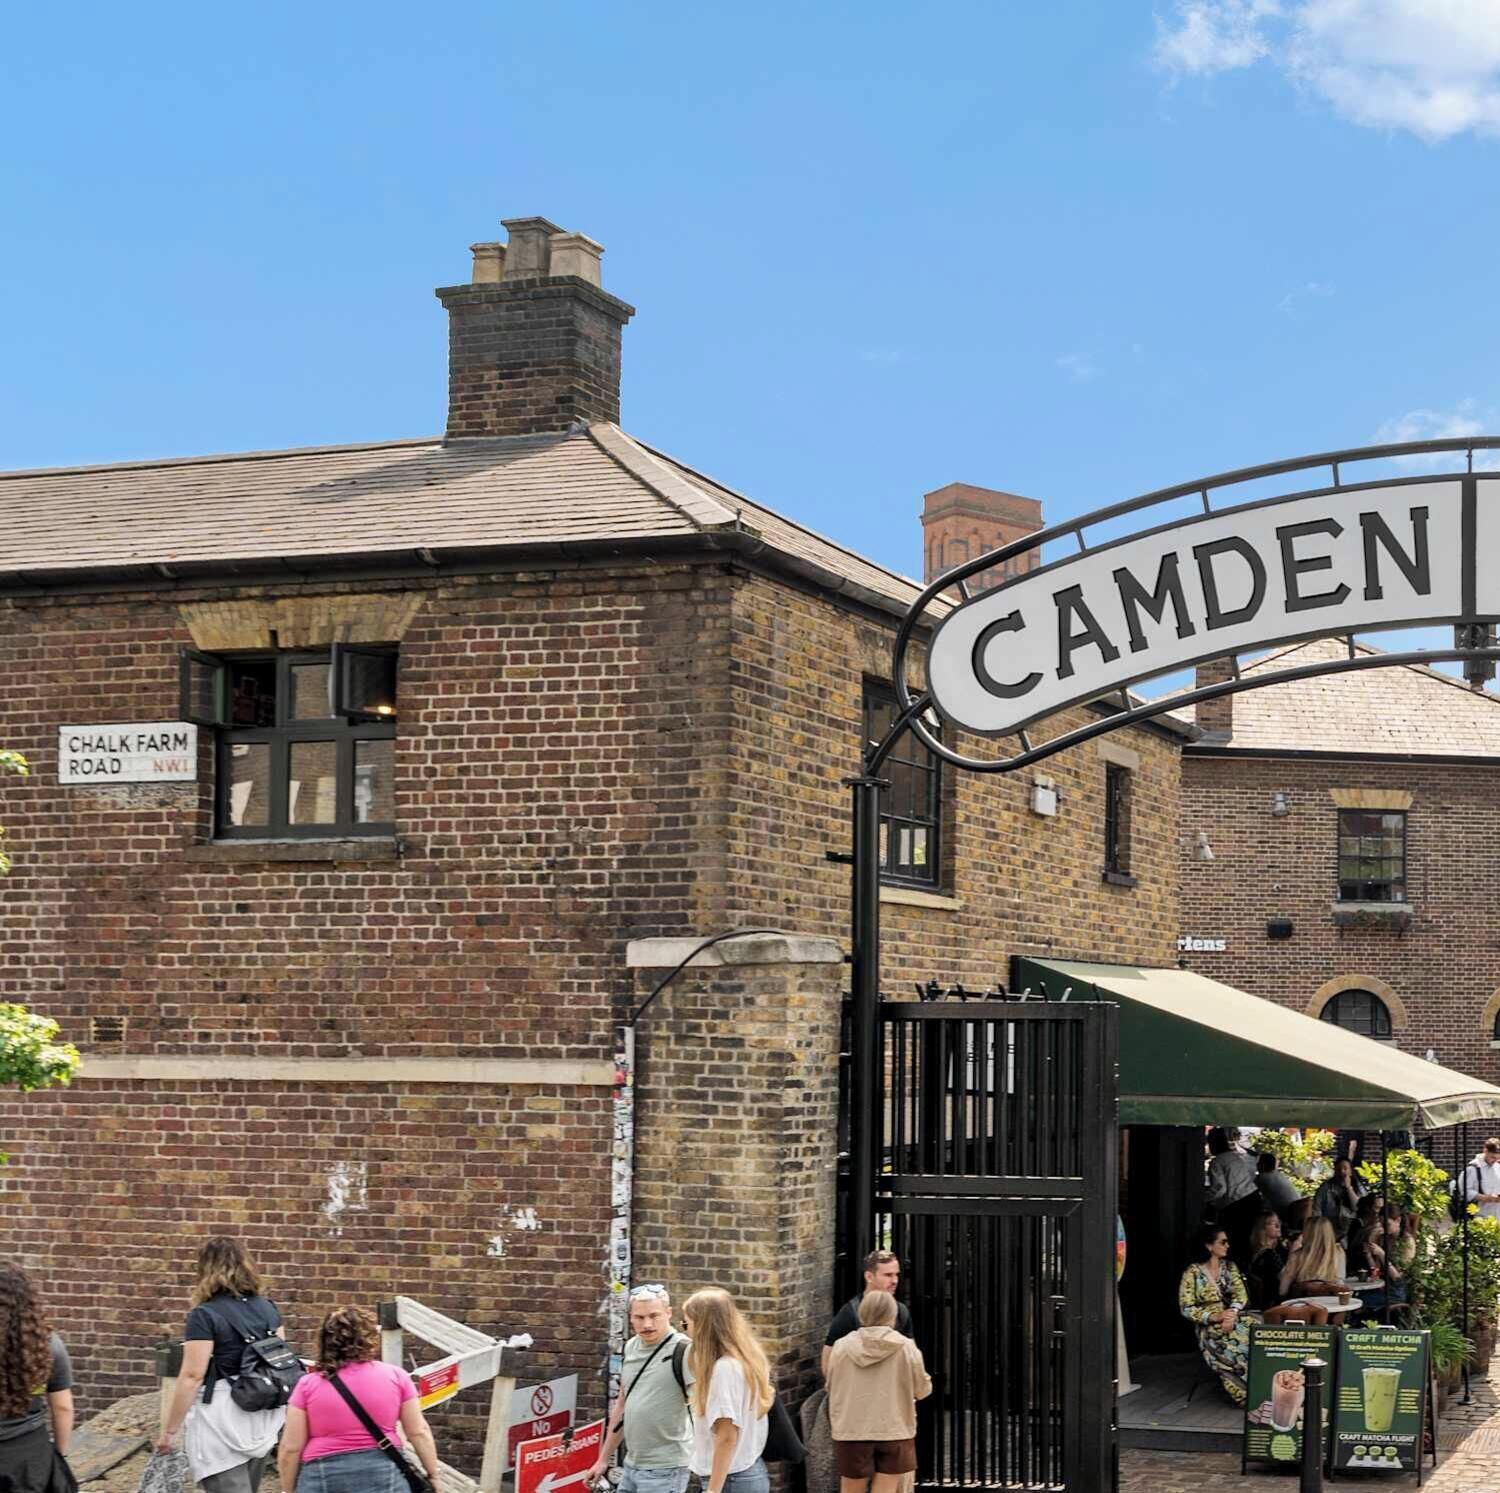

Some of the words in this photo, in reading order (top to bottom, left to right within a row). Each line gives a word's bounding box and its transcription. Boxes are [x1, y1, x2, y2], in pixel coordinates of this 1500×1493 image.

[971, 505, 1432, 699] CAMDEN
[69, 735, 131, 753] CHALK
[137, 733, 188, 752] FARM
[69, 758, 122, 775] ROAD
[153, 759, 188, 773] NW1
[1255, 1330, 1305, 1339] CHOCOLATE
[1345, 1333, 1377, 1343] CRAFT
[1382, 1334, 1422, 1344] MATCHA
[1339, 1433, 1361, 1441] CRAFT
[1362, 1434, 1391, 1442] MATCHA
[525, 1432, 600, 1464] PEDESRIANS
